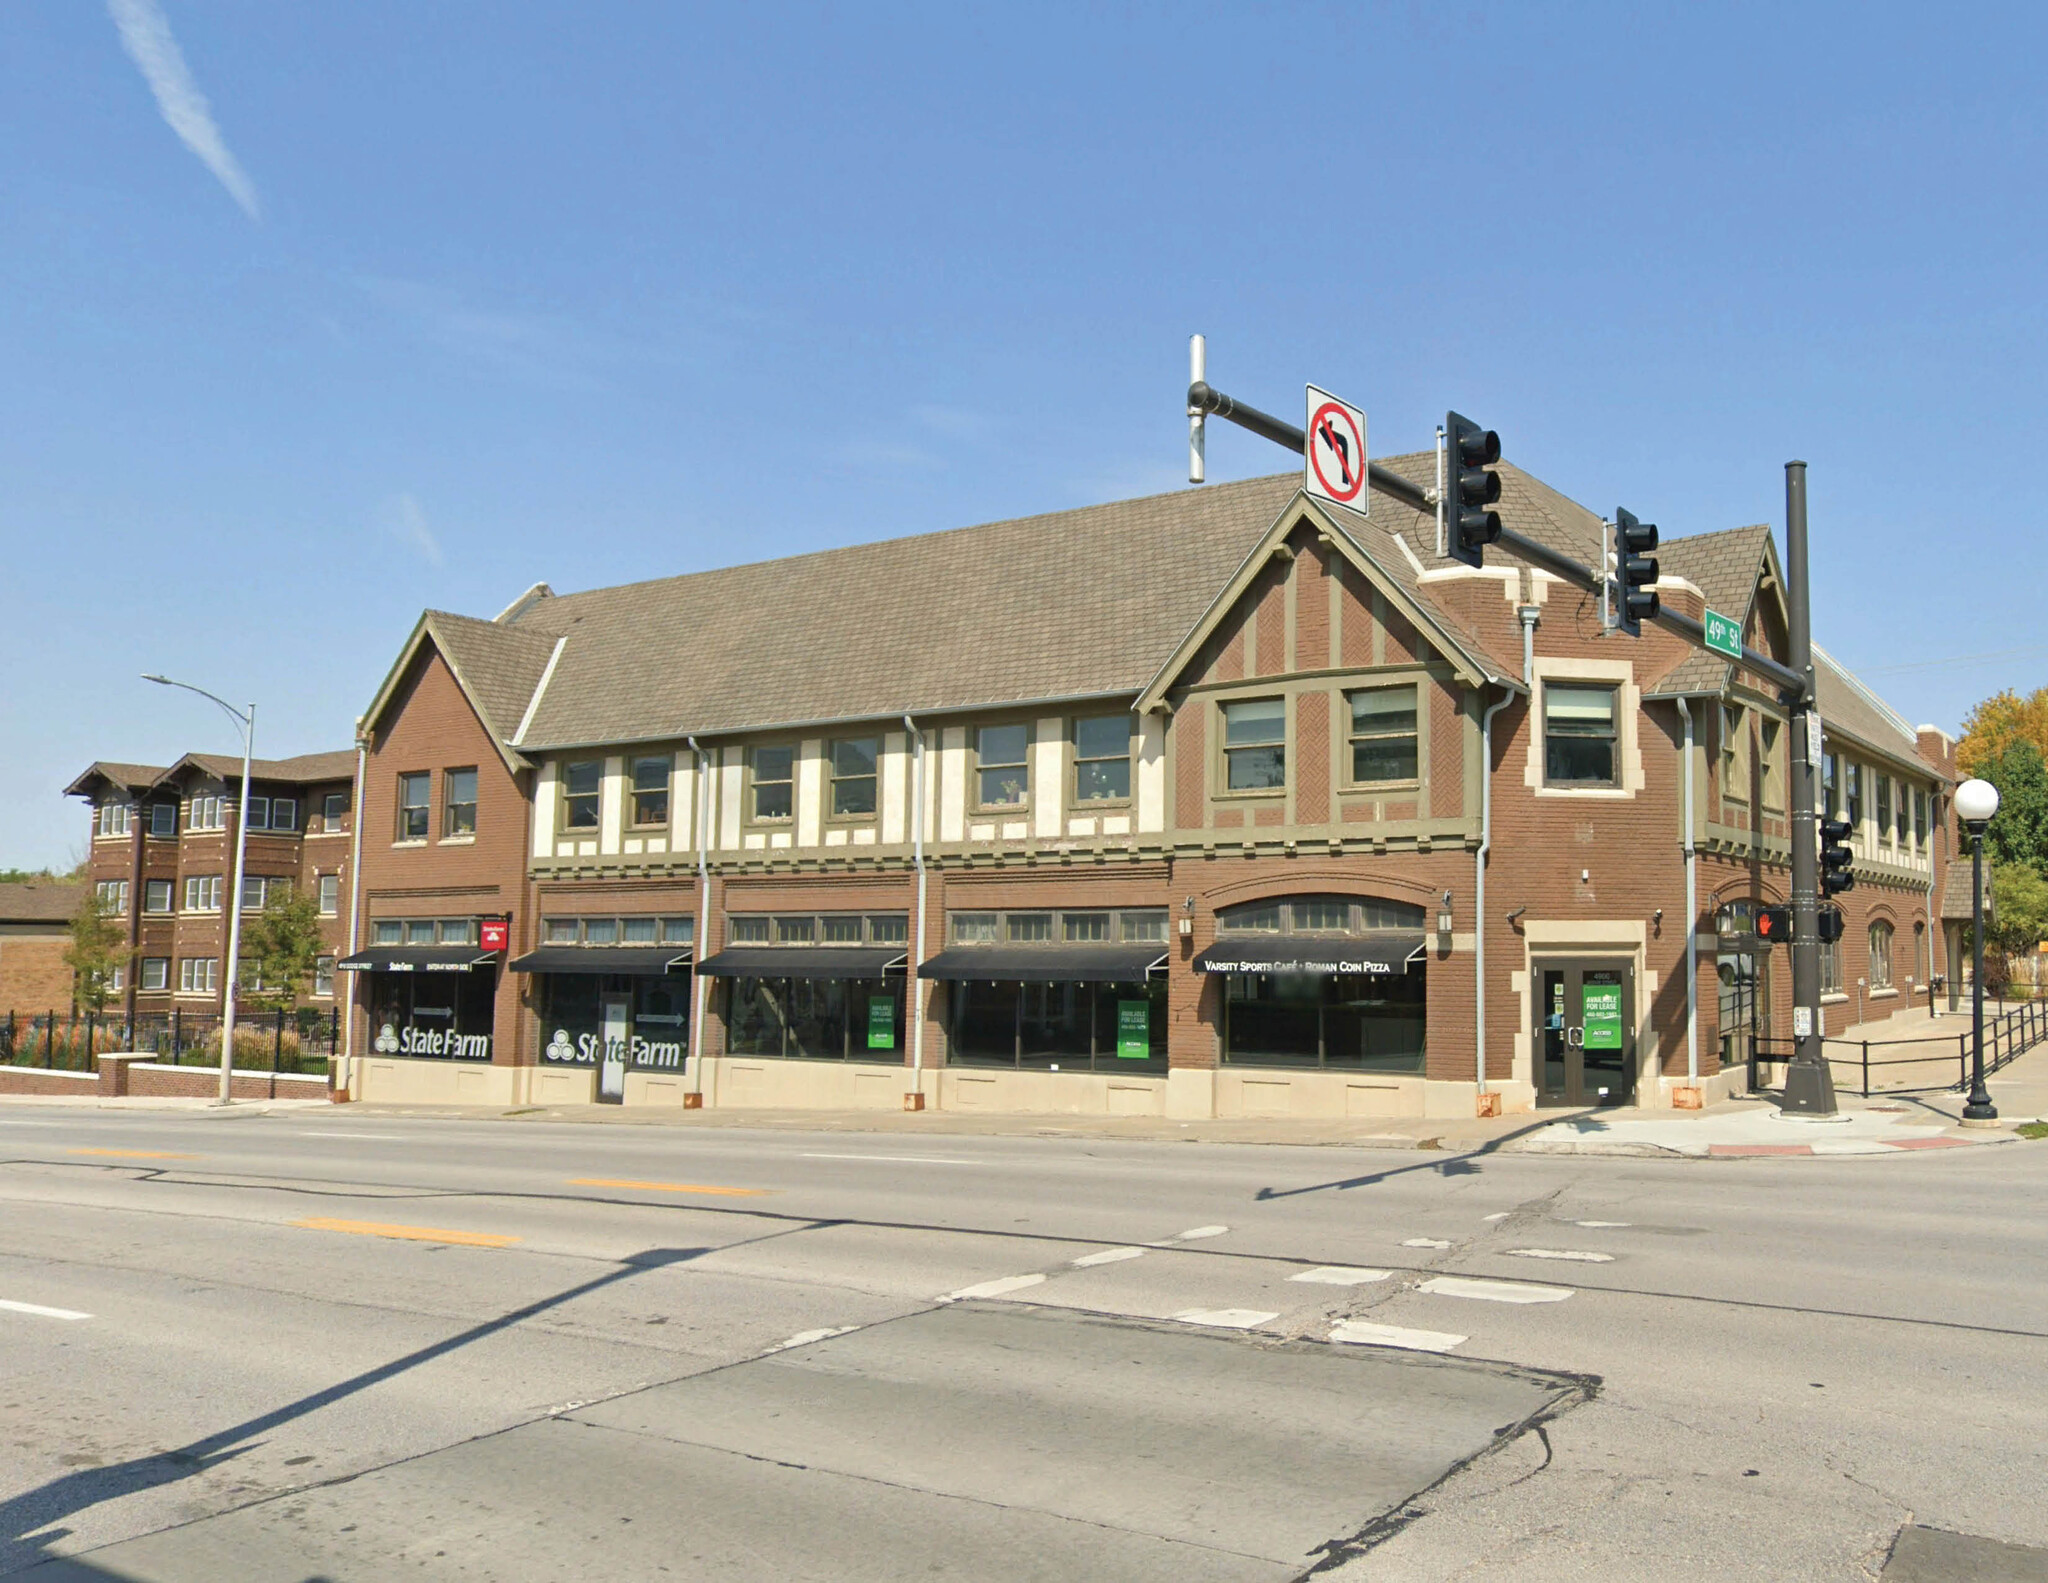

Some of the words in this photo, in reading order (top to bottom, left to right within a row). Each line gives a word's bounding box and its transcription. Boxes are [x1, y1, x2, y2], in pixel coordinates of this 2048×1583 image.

[1709, 619, 1726, 640] 49th
[1729, 627, 1739, 650] St
[1204, 960, 1239, 971] VARSITY
[1240, 961, 1272, 972] SPORTS
[1305, 961, 1337, 972] ROMAN
[1340, 961, 1362, 972] COIN
[1363, 961, 1391, 972] PIZZA
